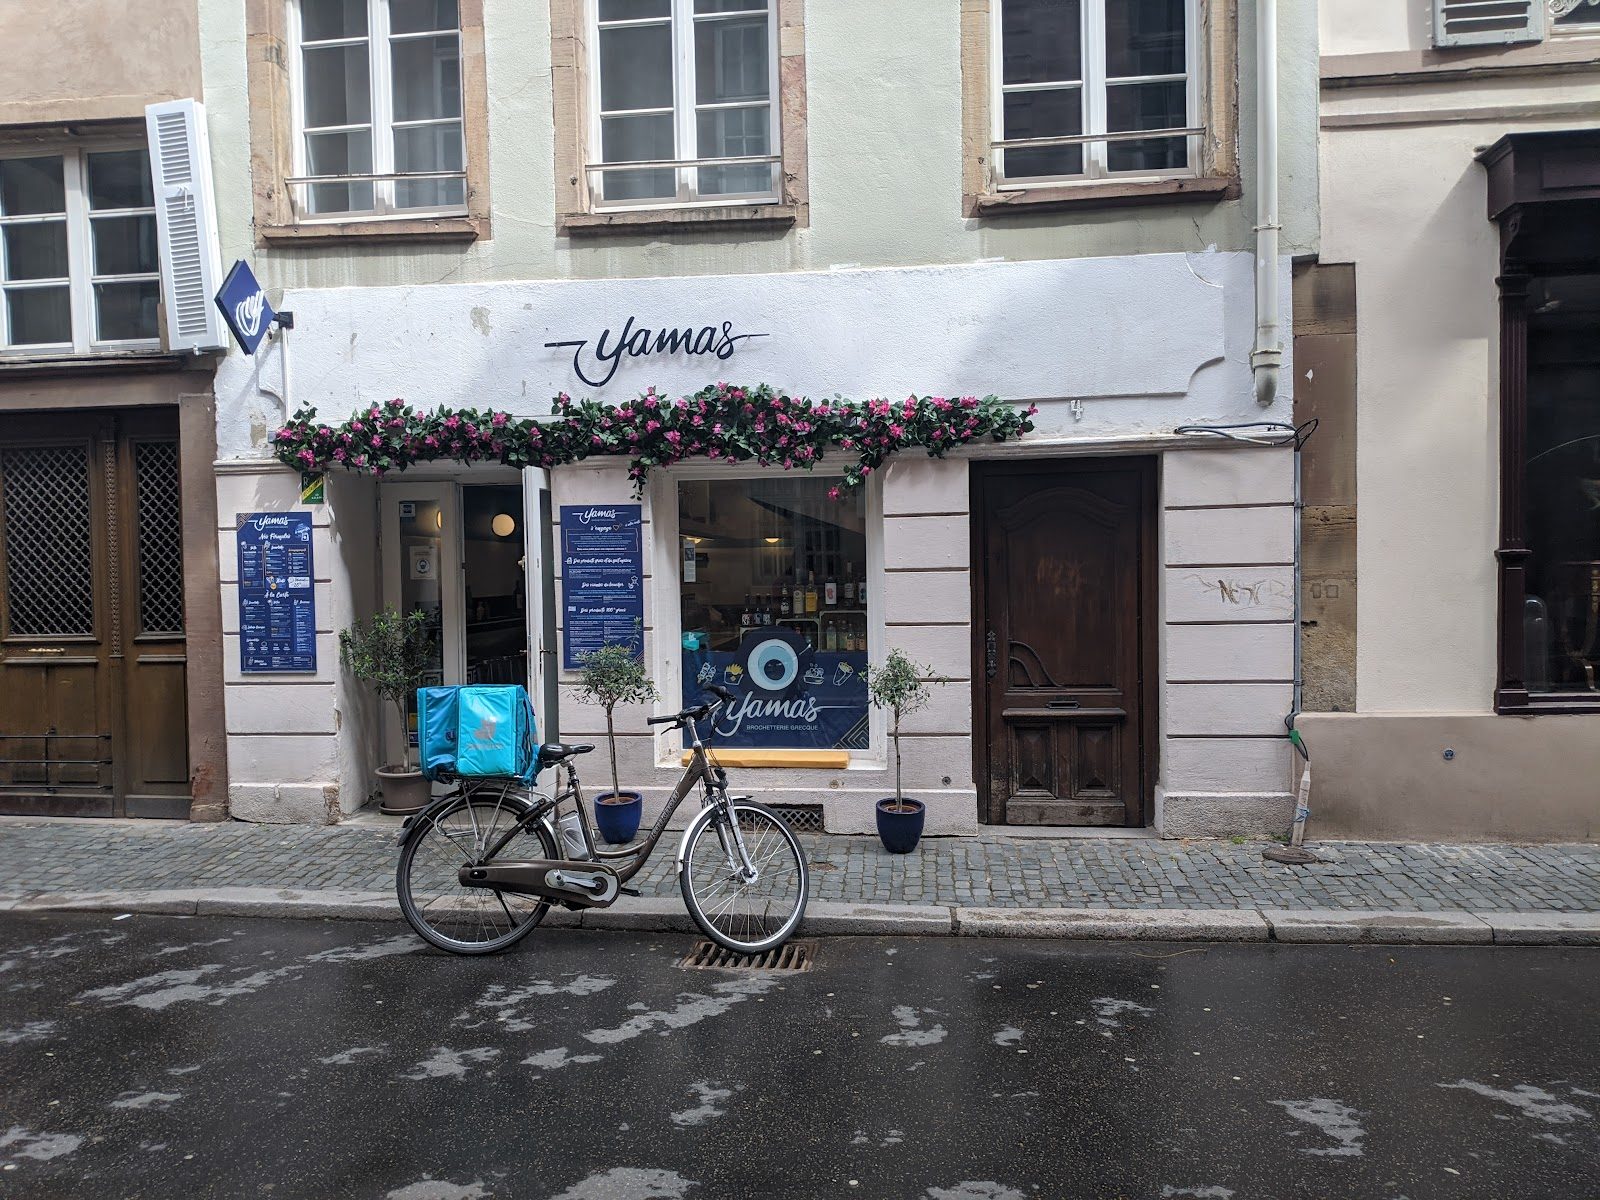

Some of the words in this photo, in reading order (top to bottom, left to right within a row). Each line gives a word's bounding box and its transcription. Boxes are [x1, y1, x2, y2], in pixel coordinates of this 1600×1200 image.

[573, 316, 740, 387] Yamas
[1070, 399, 1084, 420] 4
[254, 515, 289, 531] Yamas
[579, 508, 616, 524] Yamas
